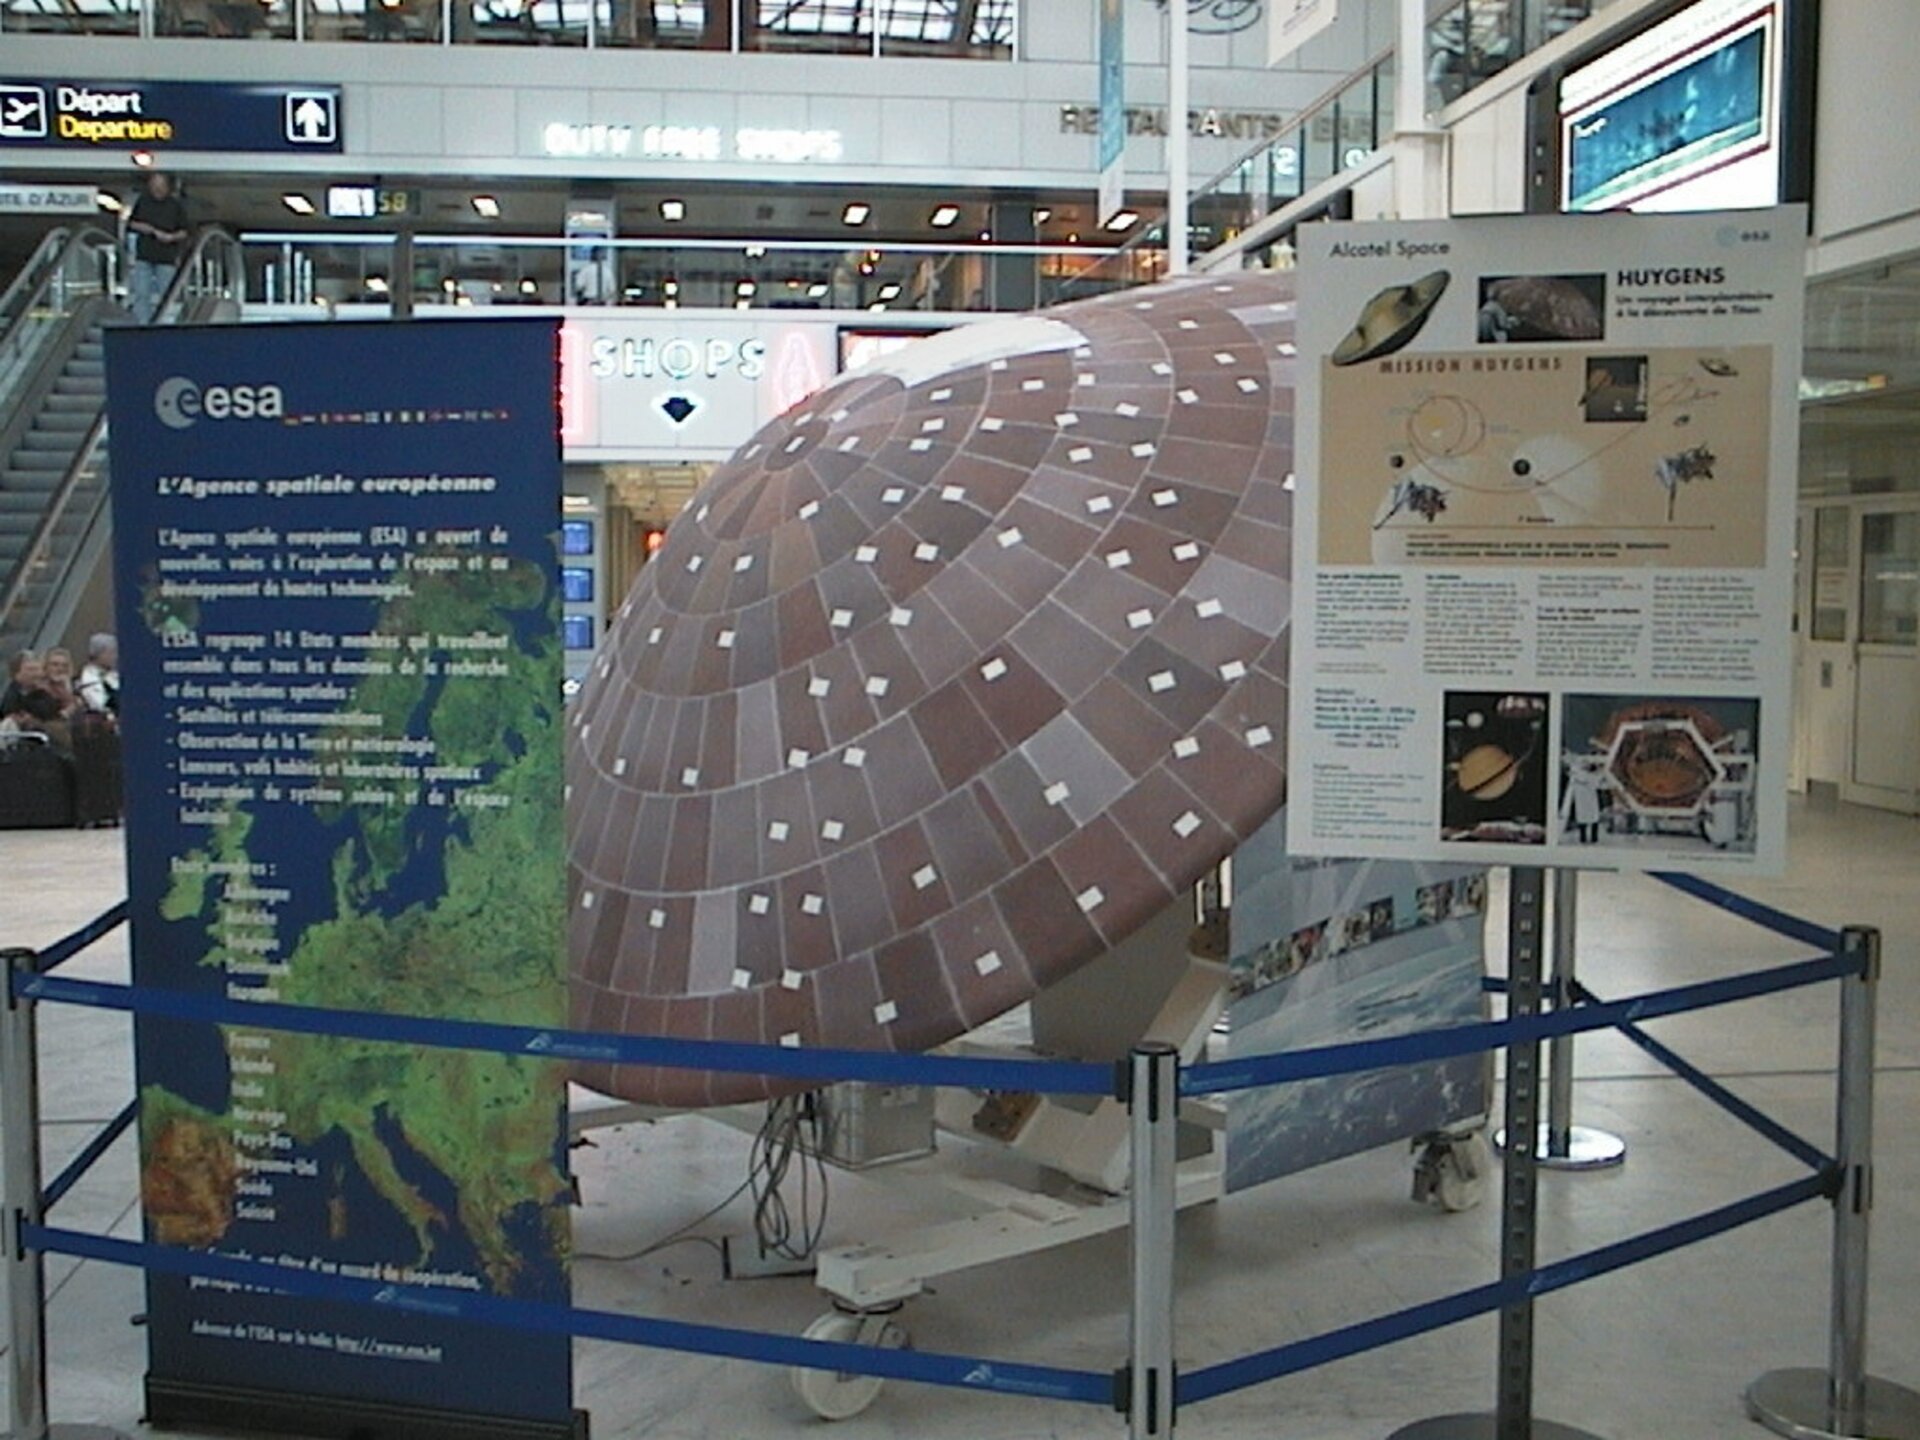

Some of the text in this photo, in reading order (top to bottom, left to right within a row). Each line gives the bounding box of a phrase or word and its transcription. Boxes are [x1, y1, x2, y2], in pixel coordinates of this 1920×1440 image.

[57, 87, 142, 116] Départ
[58, 116, 173, 142] Departure
[1060, 103, 1282, 139] RETAANTS
[1330, 240, 1451, 259] Alcatel Space
[1617, 267, 1725, 286] HUYGENS
[591, 336, 766, 380] SHOPS
[1380, 357, 1561, 373] MISSION HUYGENS
[204, 383, 283, 419] esa
[158, 472, 496, 498] L'Agence spatiale européenne
[370, 526, 407, 548] (ESA)
[435, 528, 481, 545] ouvert
[489, 525, 508, 545] de
[379, 552, 397, 572] de
[467, 554, 484, 571] et
[274, 630, 293, 649] 14
[233, 1129, 292, 1151] Pays-Bas
